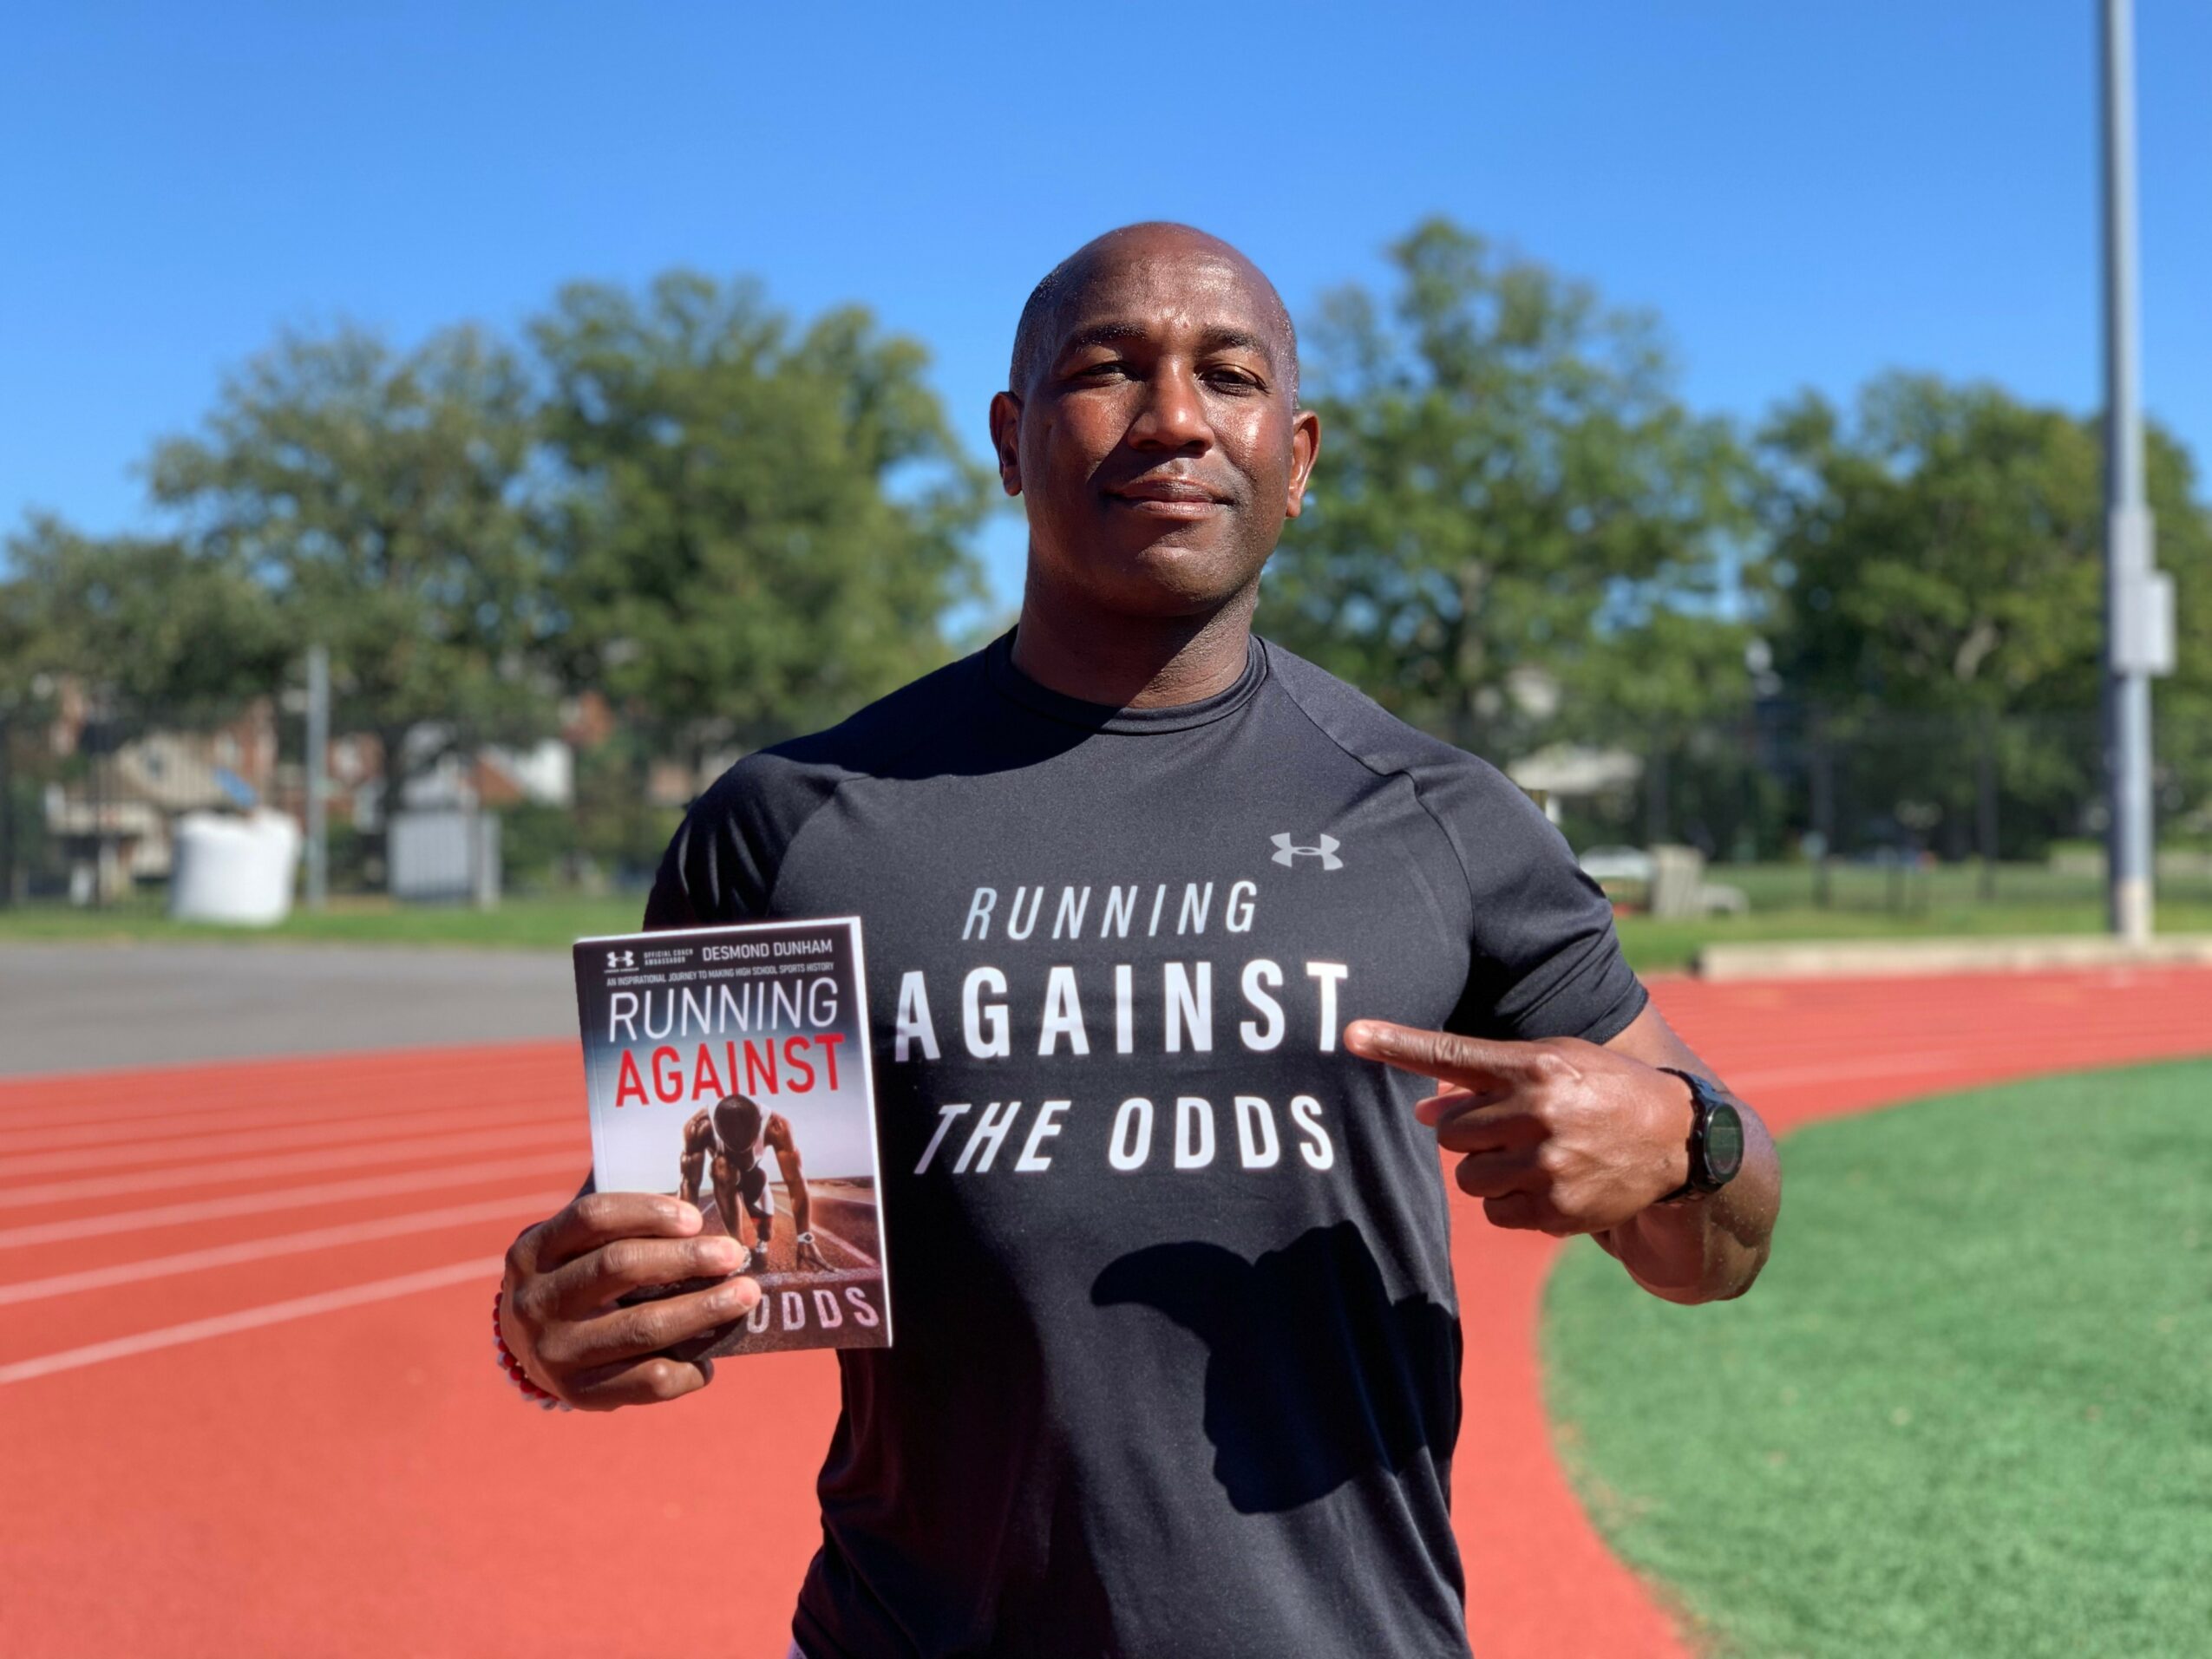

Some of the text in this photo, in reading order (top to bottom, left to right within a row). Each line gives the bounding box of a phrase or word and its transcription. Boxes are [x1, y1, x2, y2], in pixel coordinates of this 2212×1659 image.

[962, 880, 1257, 940] RUNNING
[606, 962, 834, 987] AN INSPIRATIONAL JOURNEY TO MAKING HIGH SCHOOL SPORTS HISTORY
[645, 957, 685, 966] AMBASSADOR
[703, 938, 833, 962] DESMOND DUNHAM
[609, 976, 838, 1043] RUNNING
[894, 958, 1348, 1062] AGAINST
[615, 1033, 845, 1107] AGAINST
[913, 1094, 1334, 1175] THE ODDS
[746, 1286, 880, 1334] ODDS
